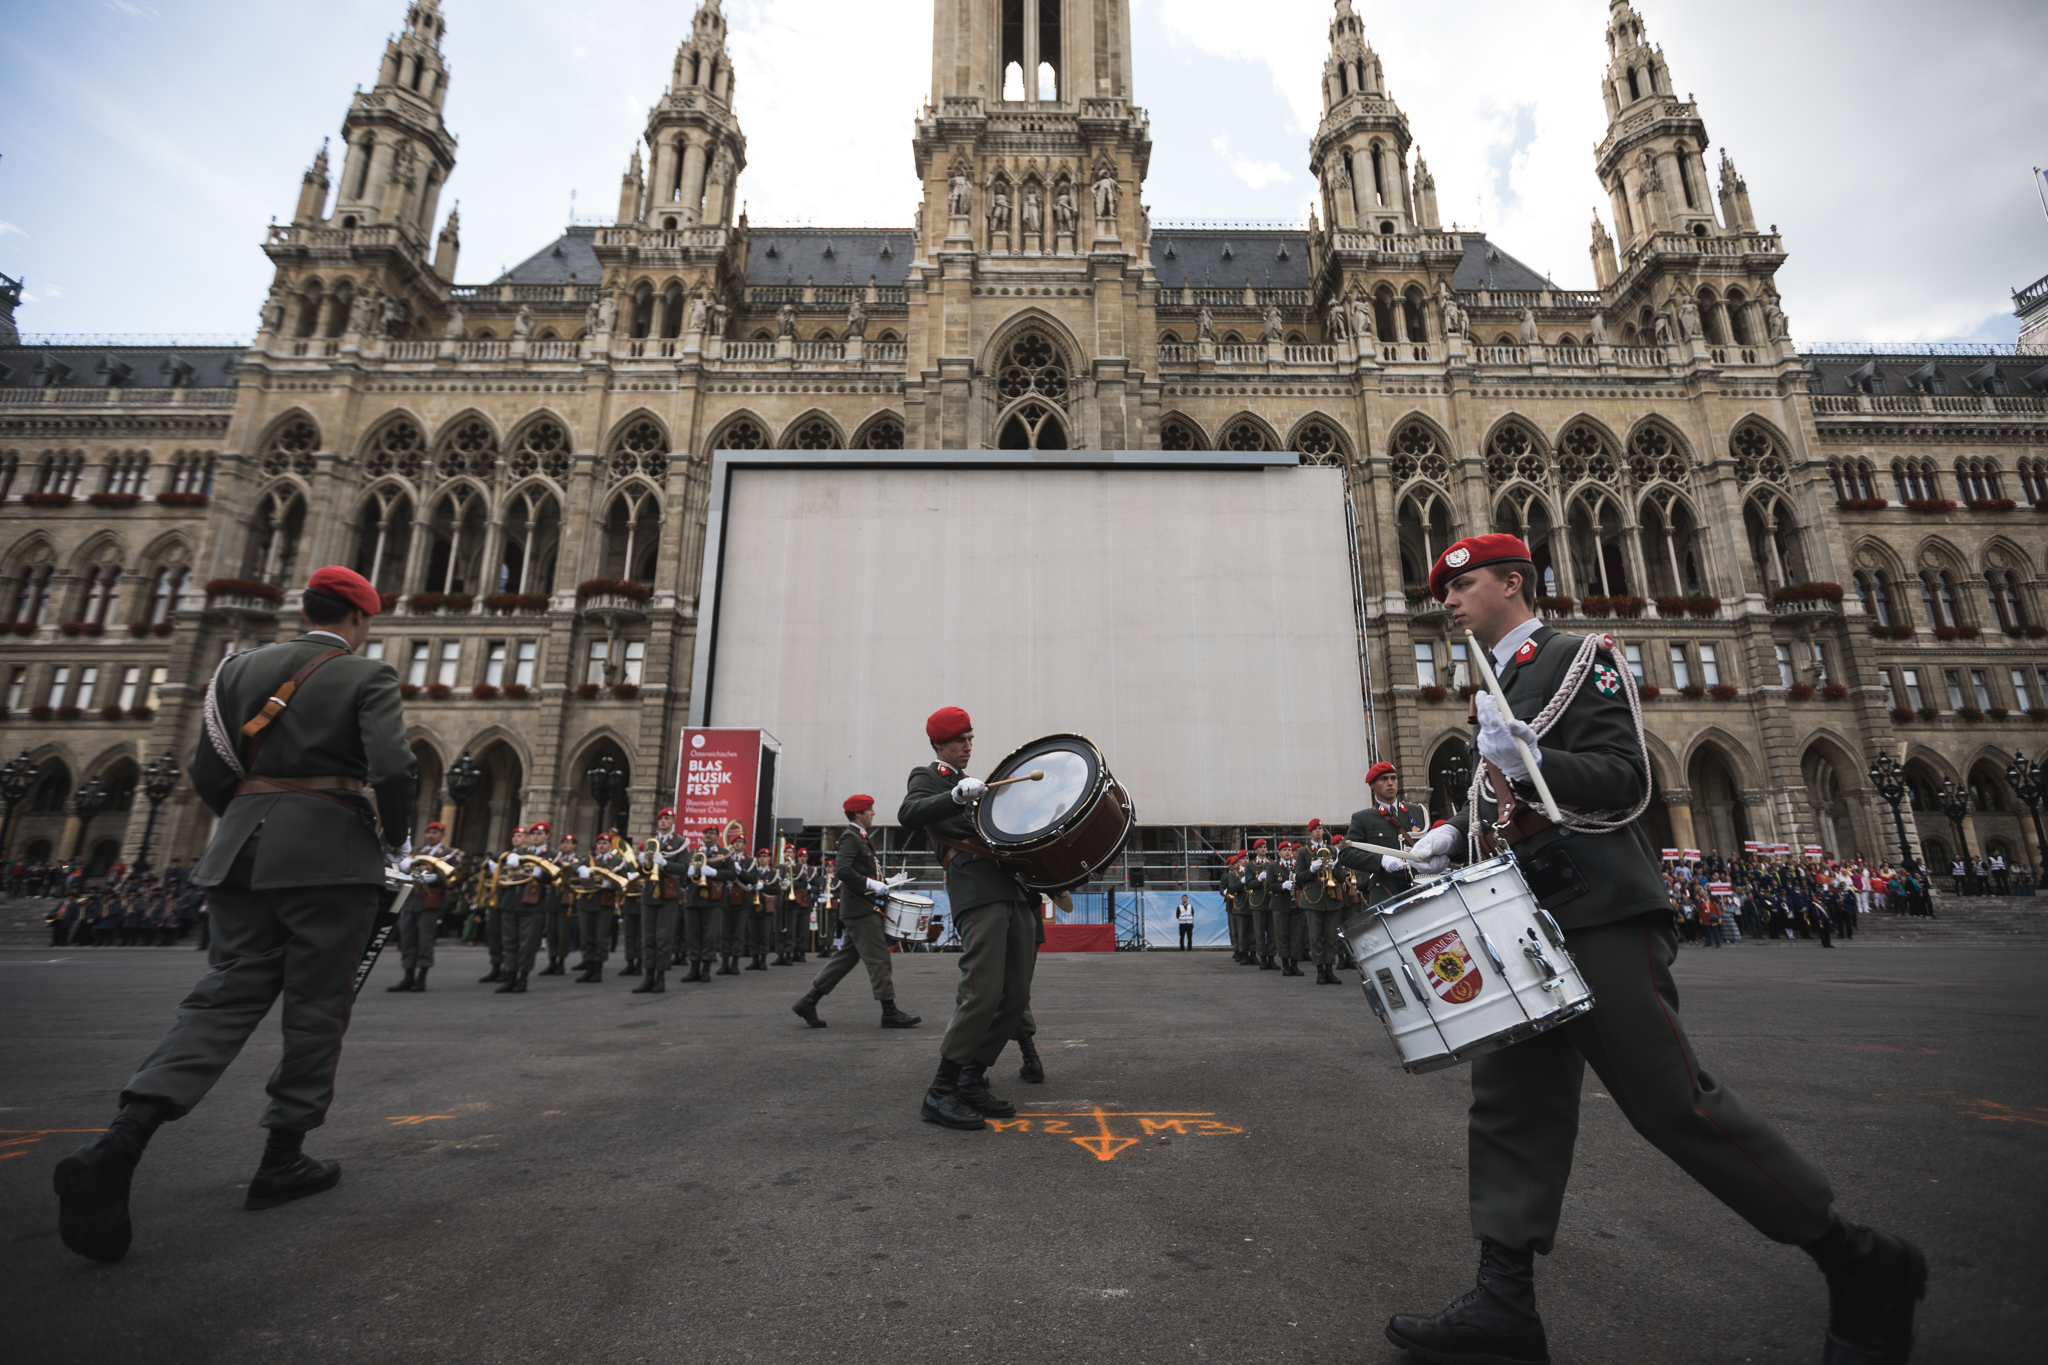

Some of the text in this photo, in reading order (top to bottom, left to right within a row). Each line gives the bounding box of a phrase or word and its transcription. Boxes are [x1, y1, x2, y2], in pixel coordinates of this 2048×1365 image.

[689, 760, 722, 771] BLAS
[688, 772, 732, 783] MUSIK
[687, 784, 719, 795] FEST
[372, 926, 393, 948] VIC
[1419, 932, 1458, 965] GARDEMUSIK
[1138, 1118, 1246, 1136] M3
